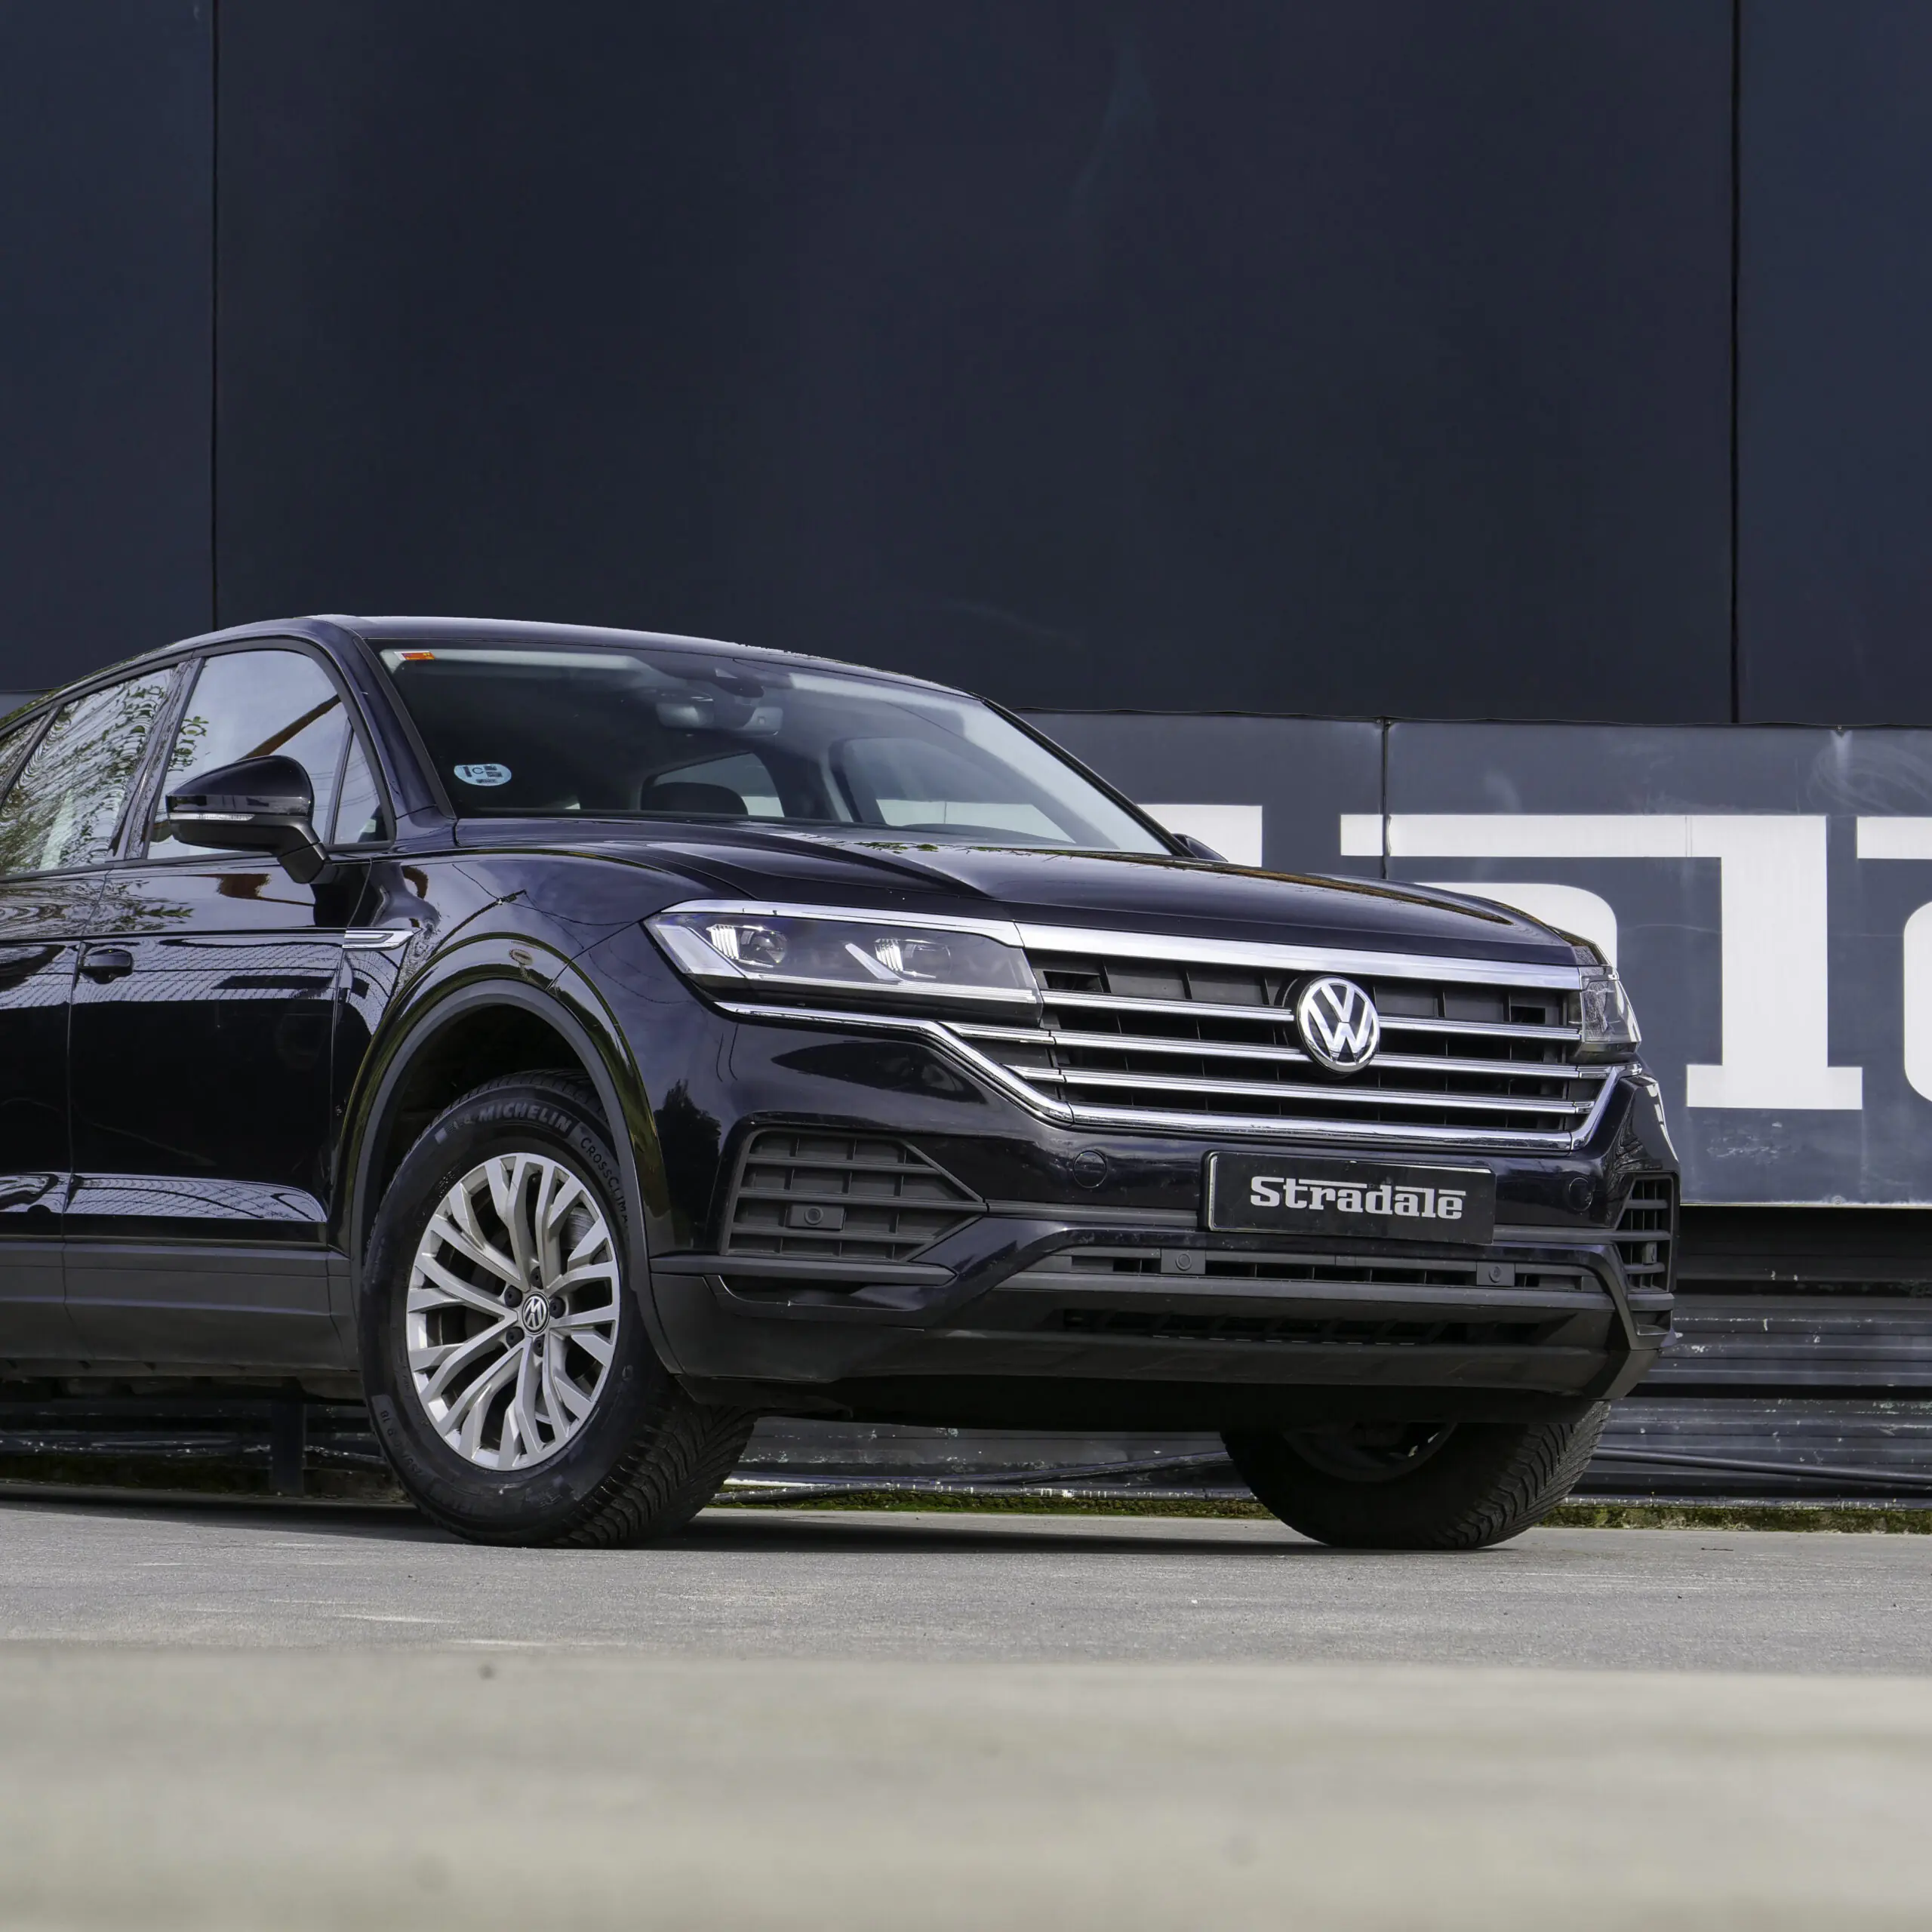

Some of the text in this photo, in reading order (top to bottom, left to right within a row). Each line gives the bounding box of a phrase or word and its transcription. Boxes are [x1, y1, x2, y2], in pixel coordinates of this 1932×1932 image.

[1301, 979, 1378, 1067] VW
[478, 1102, 629, 1229] MICHELIN CROSSCLIMA
[1251, 1176, 1466, 1220] Stradale
